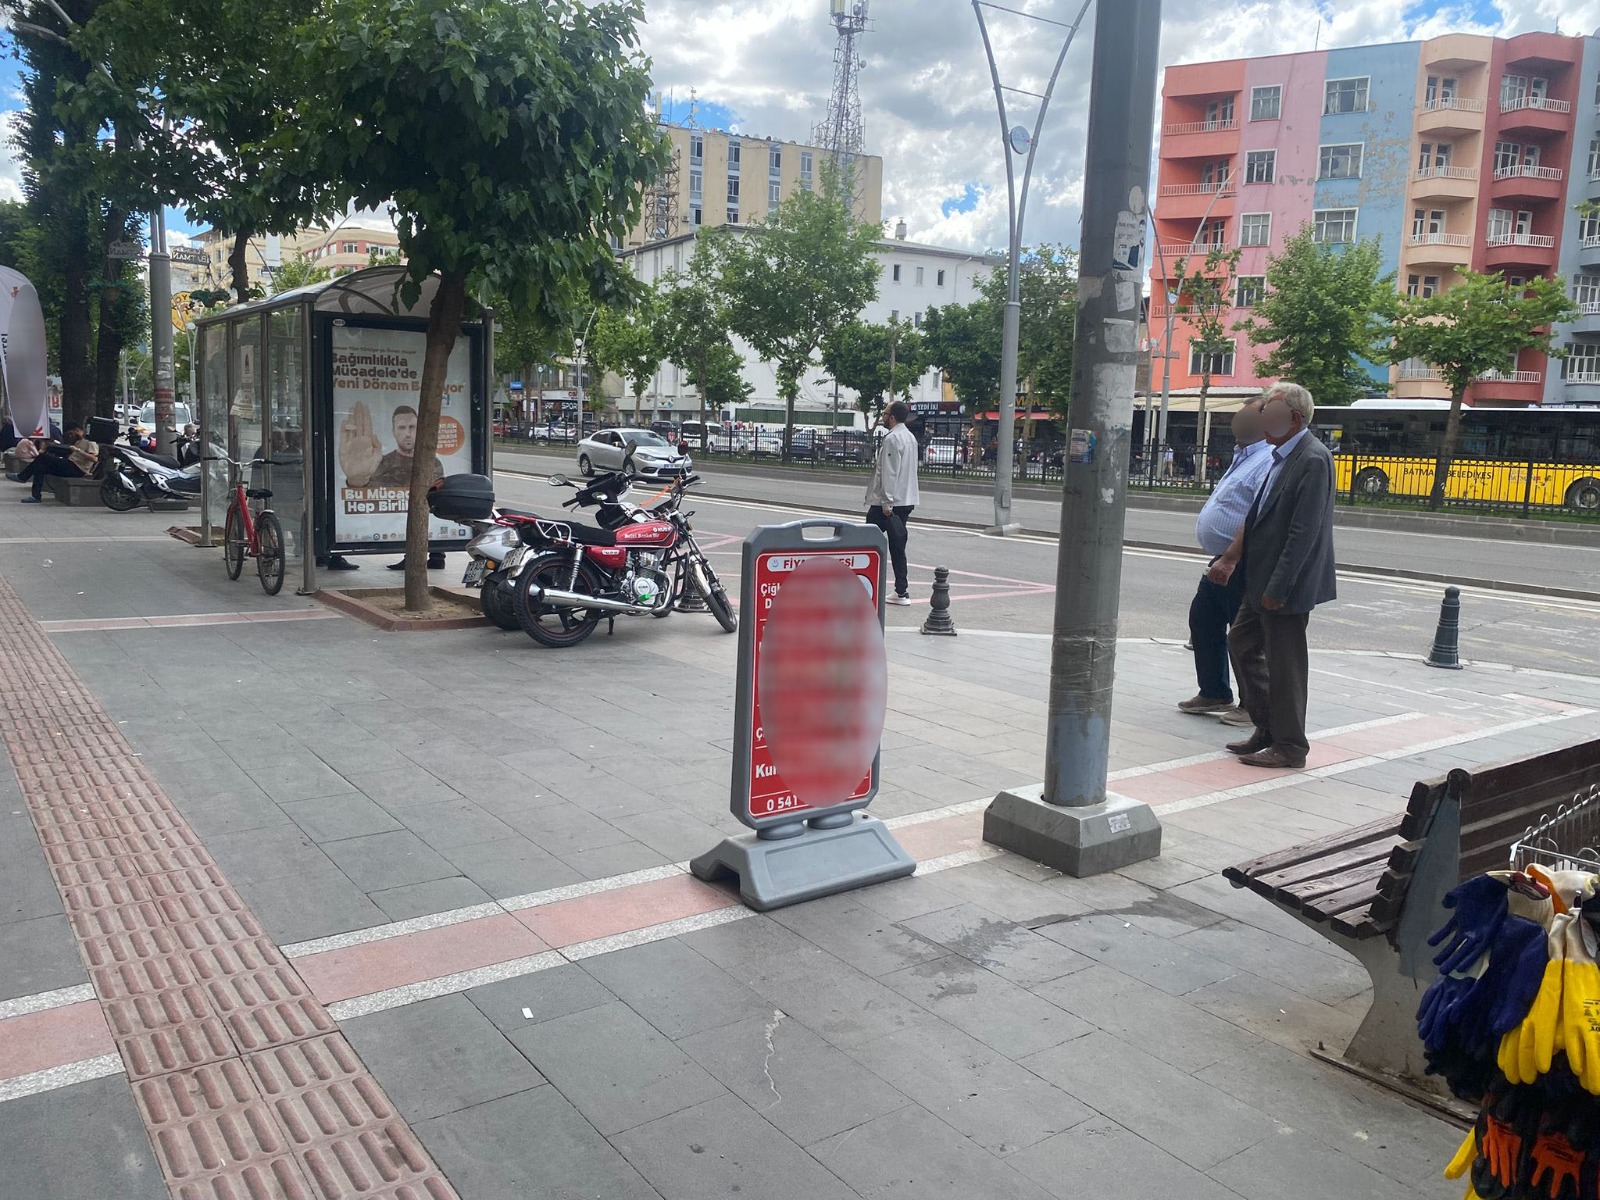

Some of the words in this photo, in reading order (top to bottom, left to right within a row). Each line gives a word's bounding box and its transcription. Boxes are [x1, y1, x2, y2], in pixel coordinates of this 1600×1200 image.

[1403, 467, 1434, 477] BATMA
[344, 489, 363, 500] Bu
[347, 501, 375, 513] Hep
